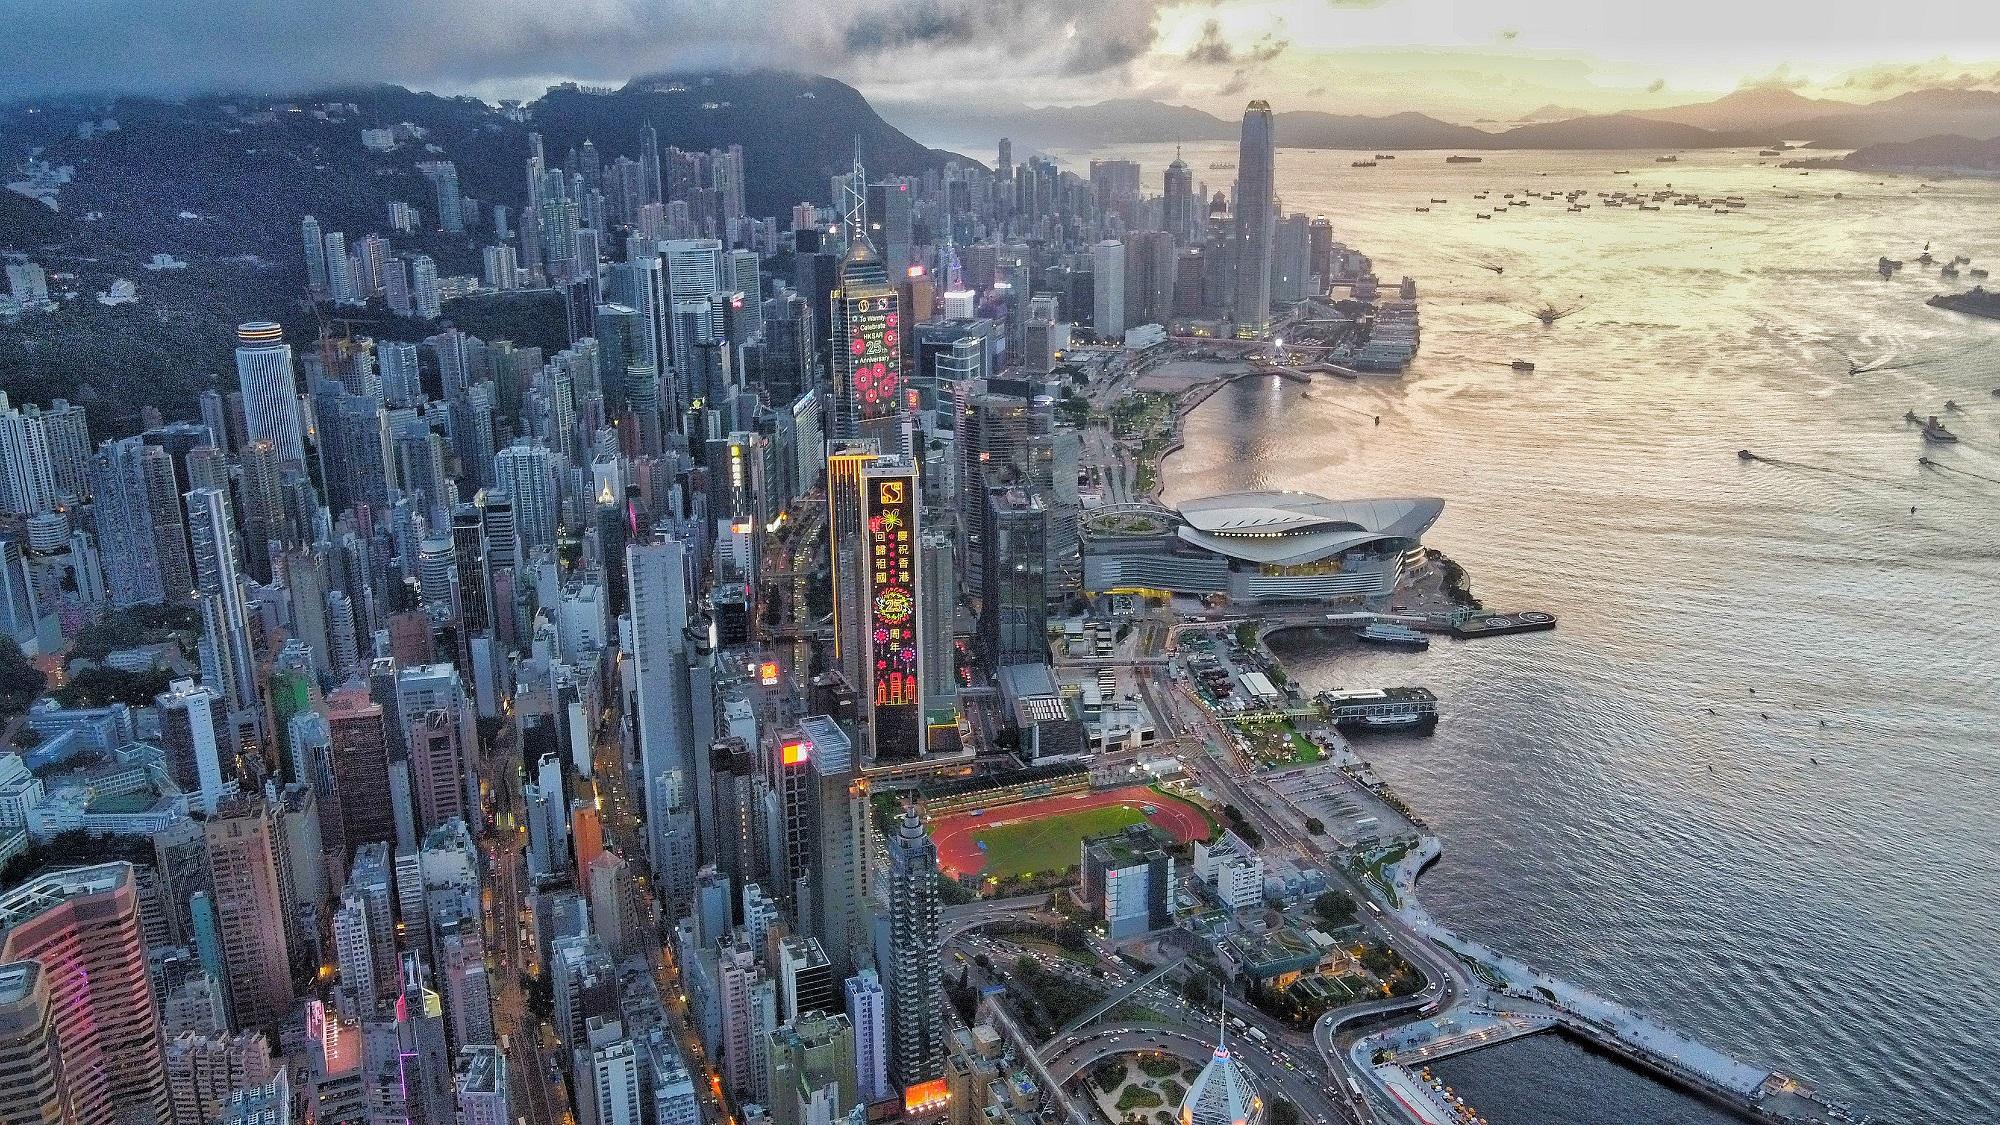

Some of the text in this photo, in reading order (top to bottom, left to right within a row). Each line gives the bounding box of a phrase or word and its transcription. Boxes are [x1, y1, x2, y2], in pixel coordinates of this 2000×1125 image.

[860, 323, 886, 331] Celebrate
[864, 332, 883, 340] HKSAR
[860, 355, 890, 364] Anniversary
[885, 600, 903, 613] 25
